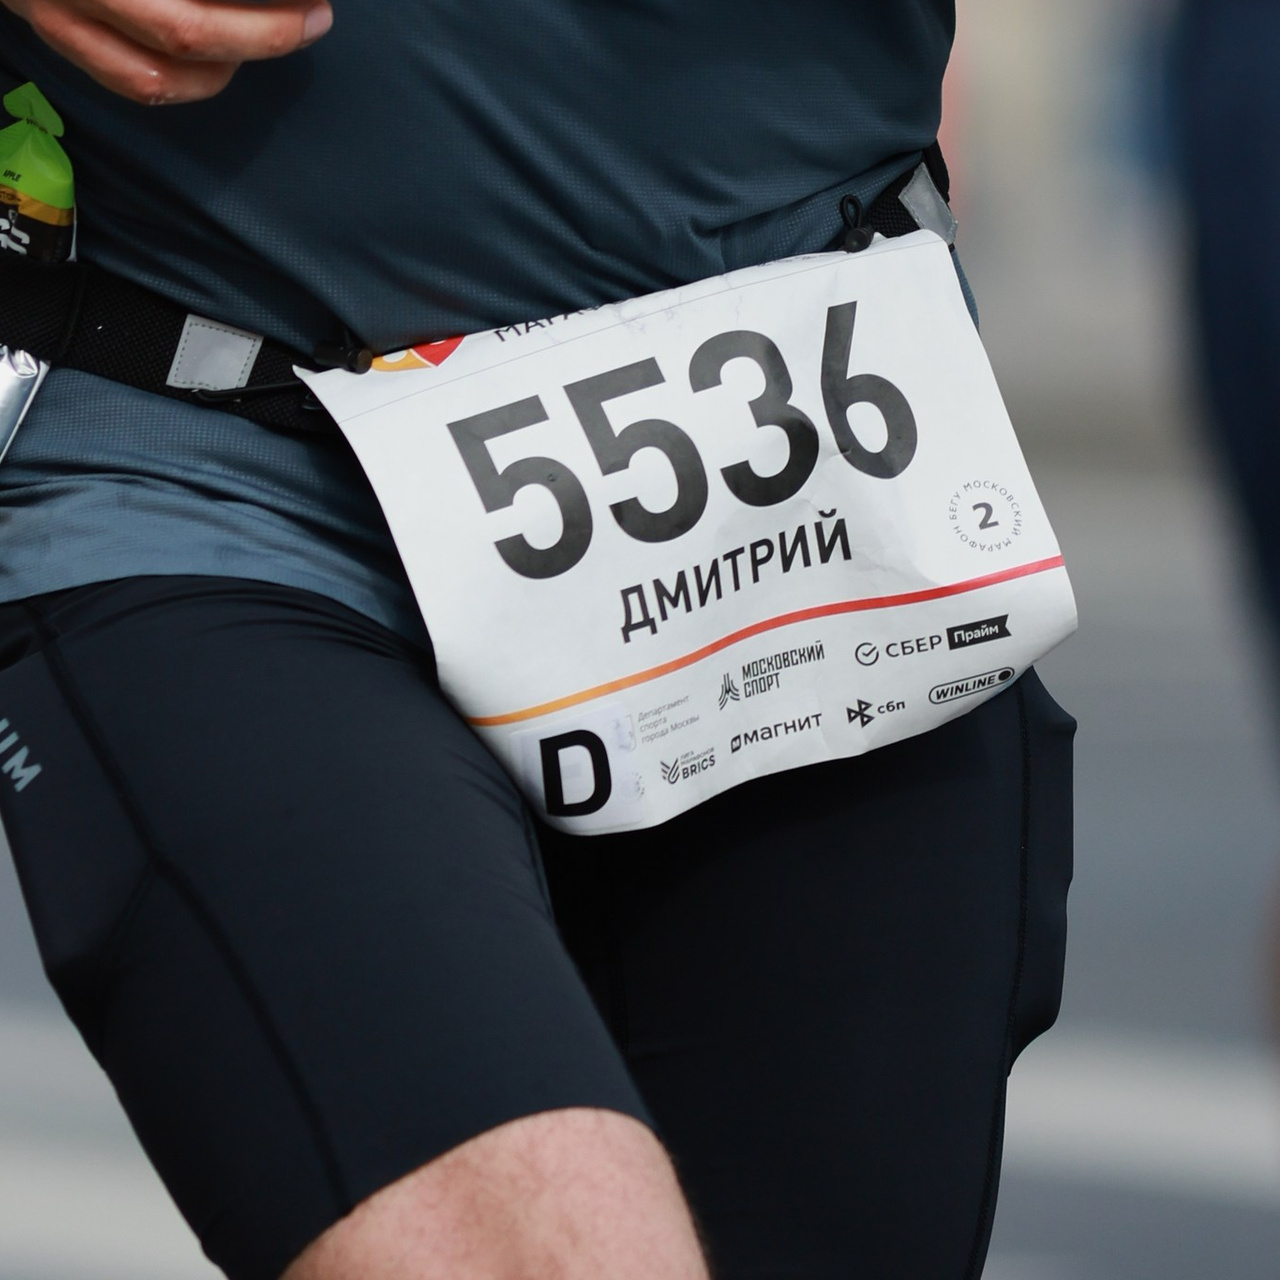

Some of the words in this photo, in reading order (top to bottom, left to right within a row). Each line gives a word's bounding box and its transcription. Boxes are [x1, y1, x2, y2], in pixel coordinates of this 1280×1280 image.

[3, 169, 21, 182] APPLE
[446, 301, 918, 580] 5536
[949, 491, 961, 520] БЕГУ
[963, 480, 1022, 536] МОСКОВСКИЙ
[972, 501, 999, 530] 2
[952, 525, 1012, 552] МАРАФОН
[620, 510, 853, 644] ДМИТРИЙ
[886, 634, 942, 658] СБЕР
[954, 623, 1000, 645] Прайм
[742, 640, 825, 681] МОСКОВСКИЙ
[744, 672, 781, 698] СПОРТ
[936, 675, 996, 701] WINLINE
[877, 700, 906, 715] сбп
[542, 729, 612, 817] D
[682, 755, 716, 780] BRICS
